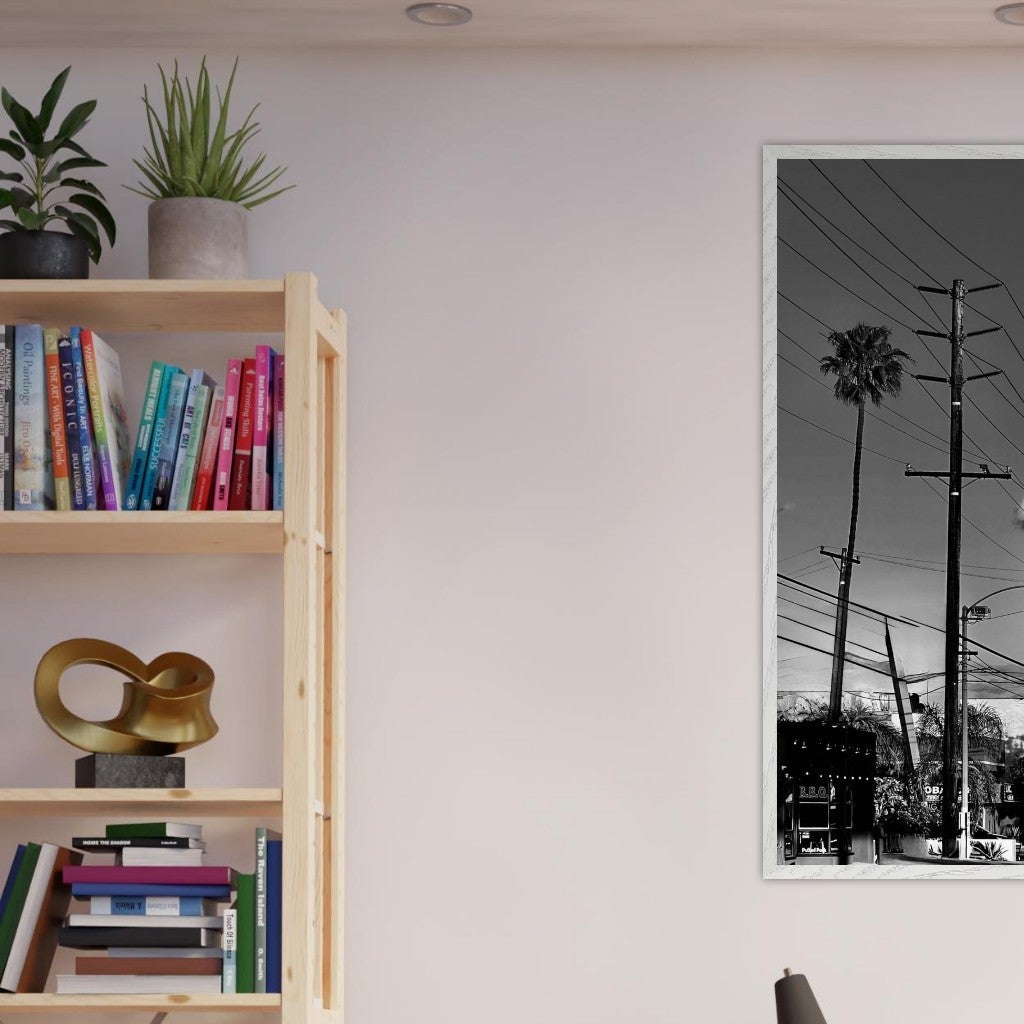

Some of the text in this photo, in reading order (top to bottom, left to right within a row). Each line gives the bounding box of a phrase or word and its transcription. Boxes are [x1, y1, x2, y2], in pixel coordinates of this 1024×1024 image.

[20, 342, 34, 405] Oil Paintings
[49, 365, 57, 381] FINE
[51, 383, 59, 398] ART
[62, 362, 78, 430] ICONIC
[84, 343, 102, 432] Watercolor Portraits
[52, 405, 61, 422] With
[144, 399, 156, 421] MEALS
[242, 382, 253, 437] Parenting Skills
[52, 423, 64, 447] Digital
[54, 449, 64, 465] Tools
[85, 463, 94, 496] NORMAN
[258, 836, 266, 857] The
[225, 913, 233, 930] Touch
